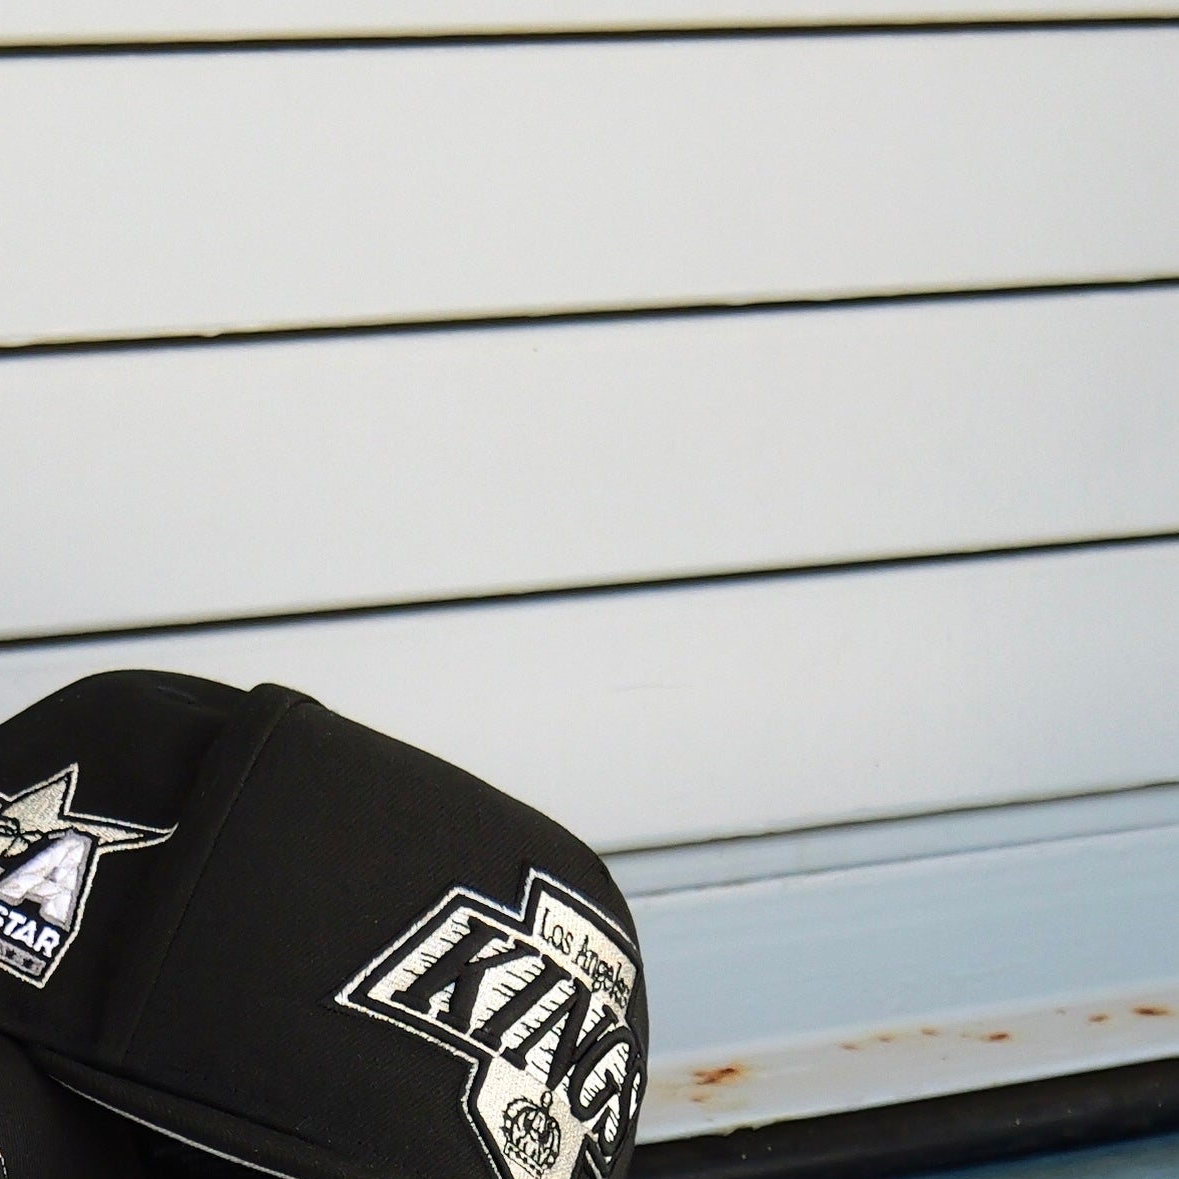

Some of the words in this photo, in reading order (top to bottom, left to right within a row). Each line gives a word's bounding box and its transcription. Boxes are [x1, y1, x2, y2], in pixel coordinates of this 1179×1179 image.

[391, 917, 647, 1158] KINGS
[539, 907, 574, 955] Los
[572, 934, 630, 1009] Angeles
